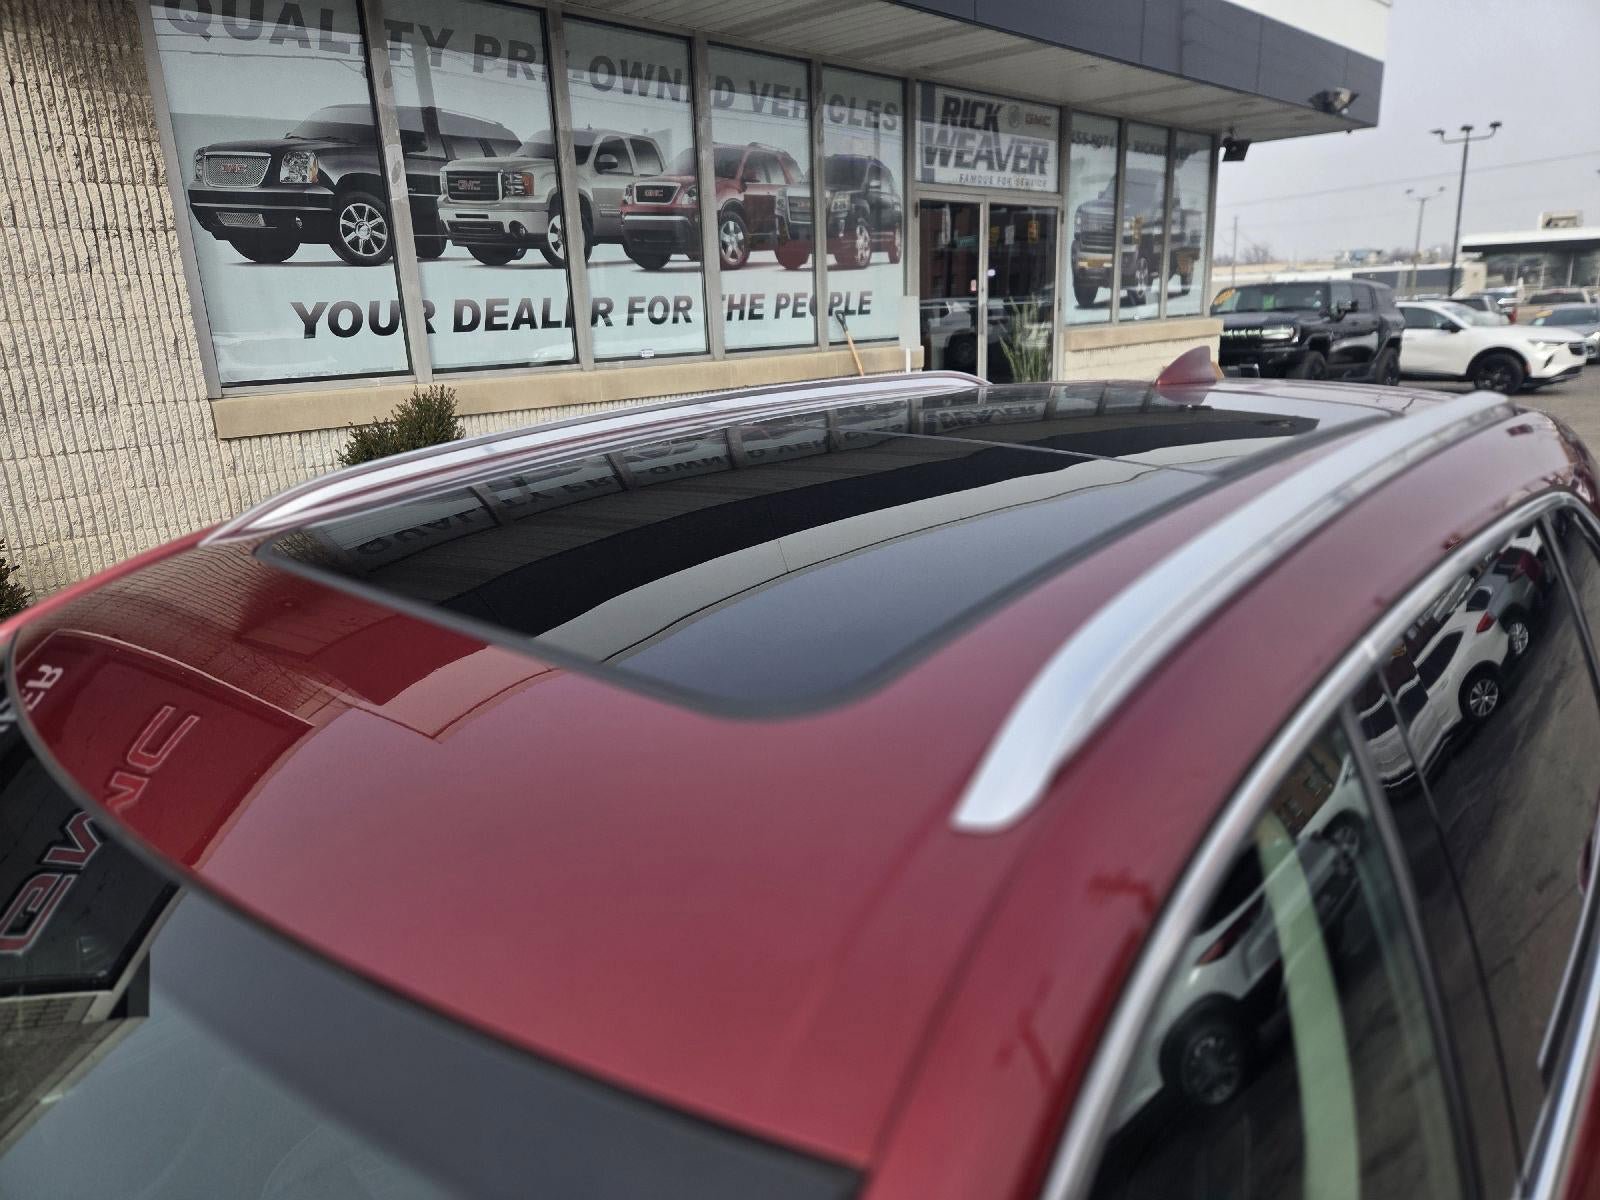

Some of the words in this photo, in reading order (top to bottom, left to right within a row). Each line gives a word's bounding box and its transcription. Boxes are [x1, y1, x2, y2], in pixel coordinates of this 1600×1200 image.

[940, 95, 1002, 133] RICK
[923, 124, 1049, 176] WEAVER
[626, 294, 693, 327] FOR
[721, 293, 766, 322] HE
